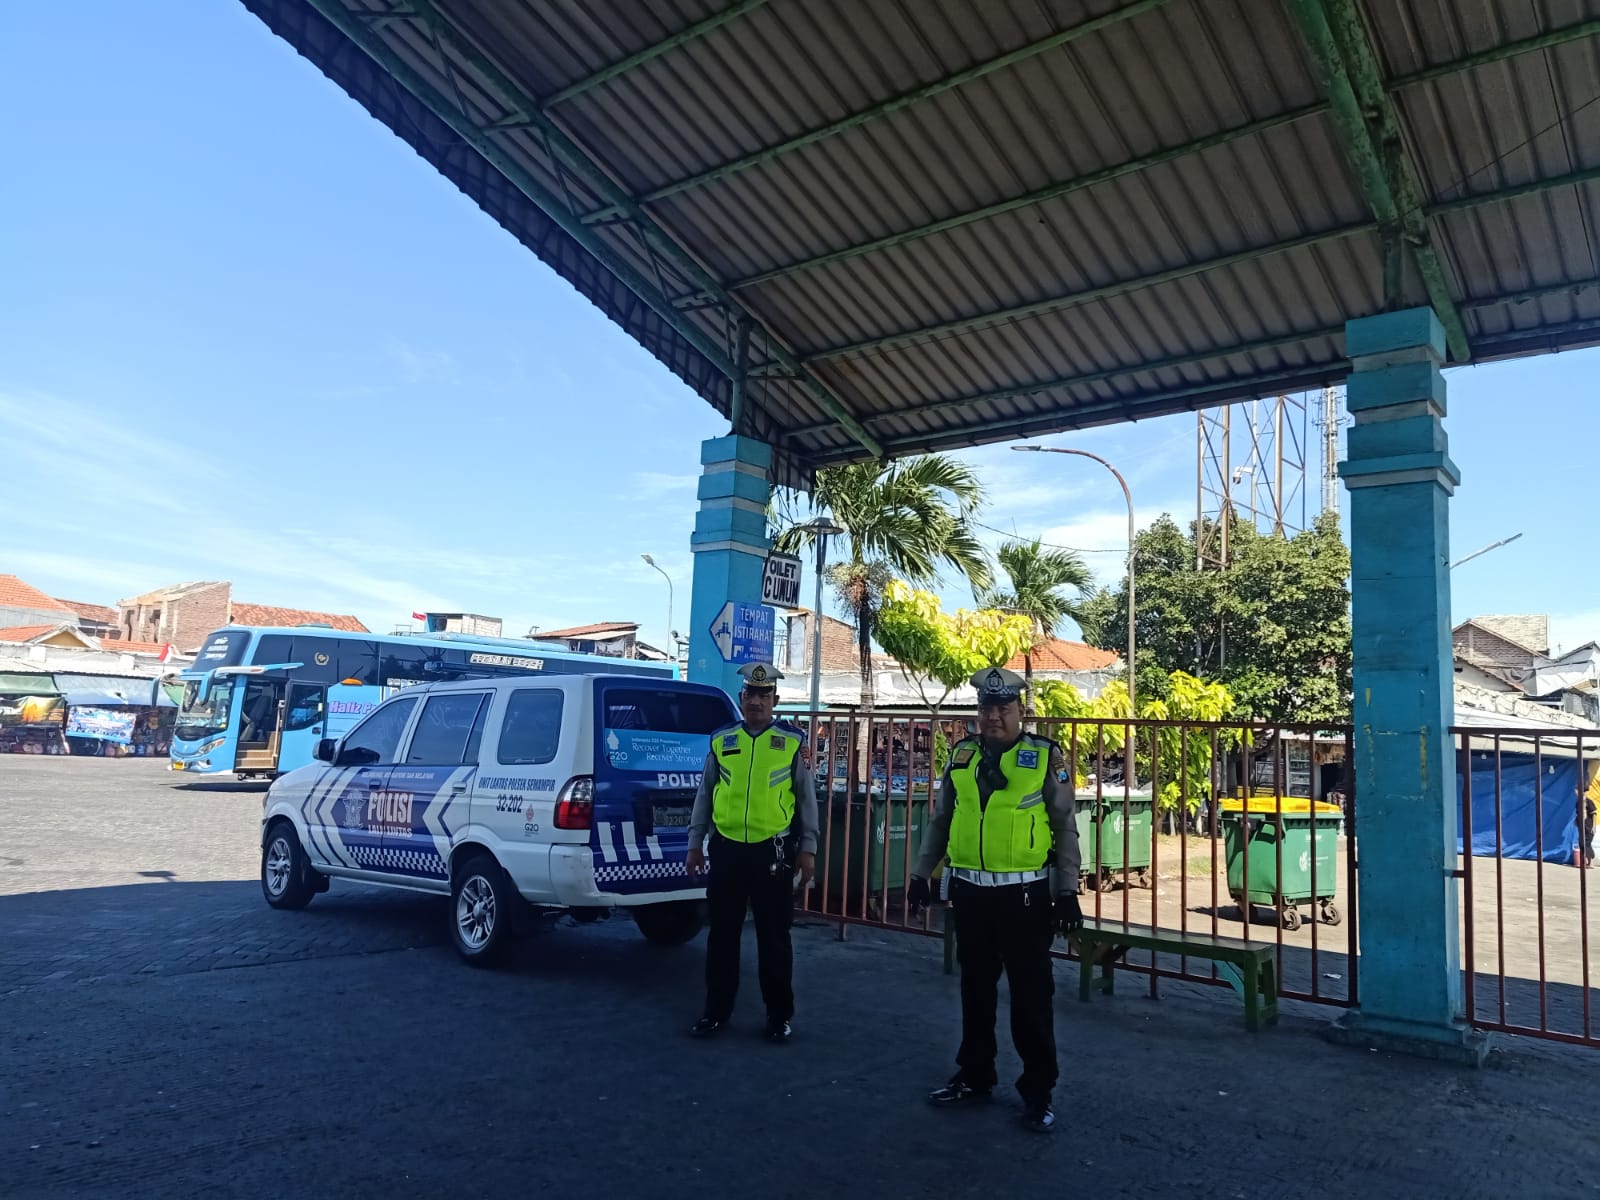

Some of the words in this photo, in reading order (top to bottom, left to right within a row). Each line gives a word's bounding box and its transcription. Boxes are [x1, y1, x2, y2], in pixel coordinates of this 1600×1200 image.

[740, 608, 769, 623] TEMPAT
[734, 625, 772, 642] ISTIRAHAT
[328, 701, 361, 714] Hafiz
[632, 743, 659, 752] Recover
[662, 744, 691, 754] Together
[646, 752, 673, 762] Recover
[657, 773, 702, 787] POLIS
[368, 792, 413, 824] POLISI
[496, 794, 523, 813] 32-202
[525, 823, 539, 832] G20
